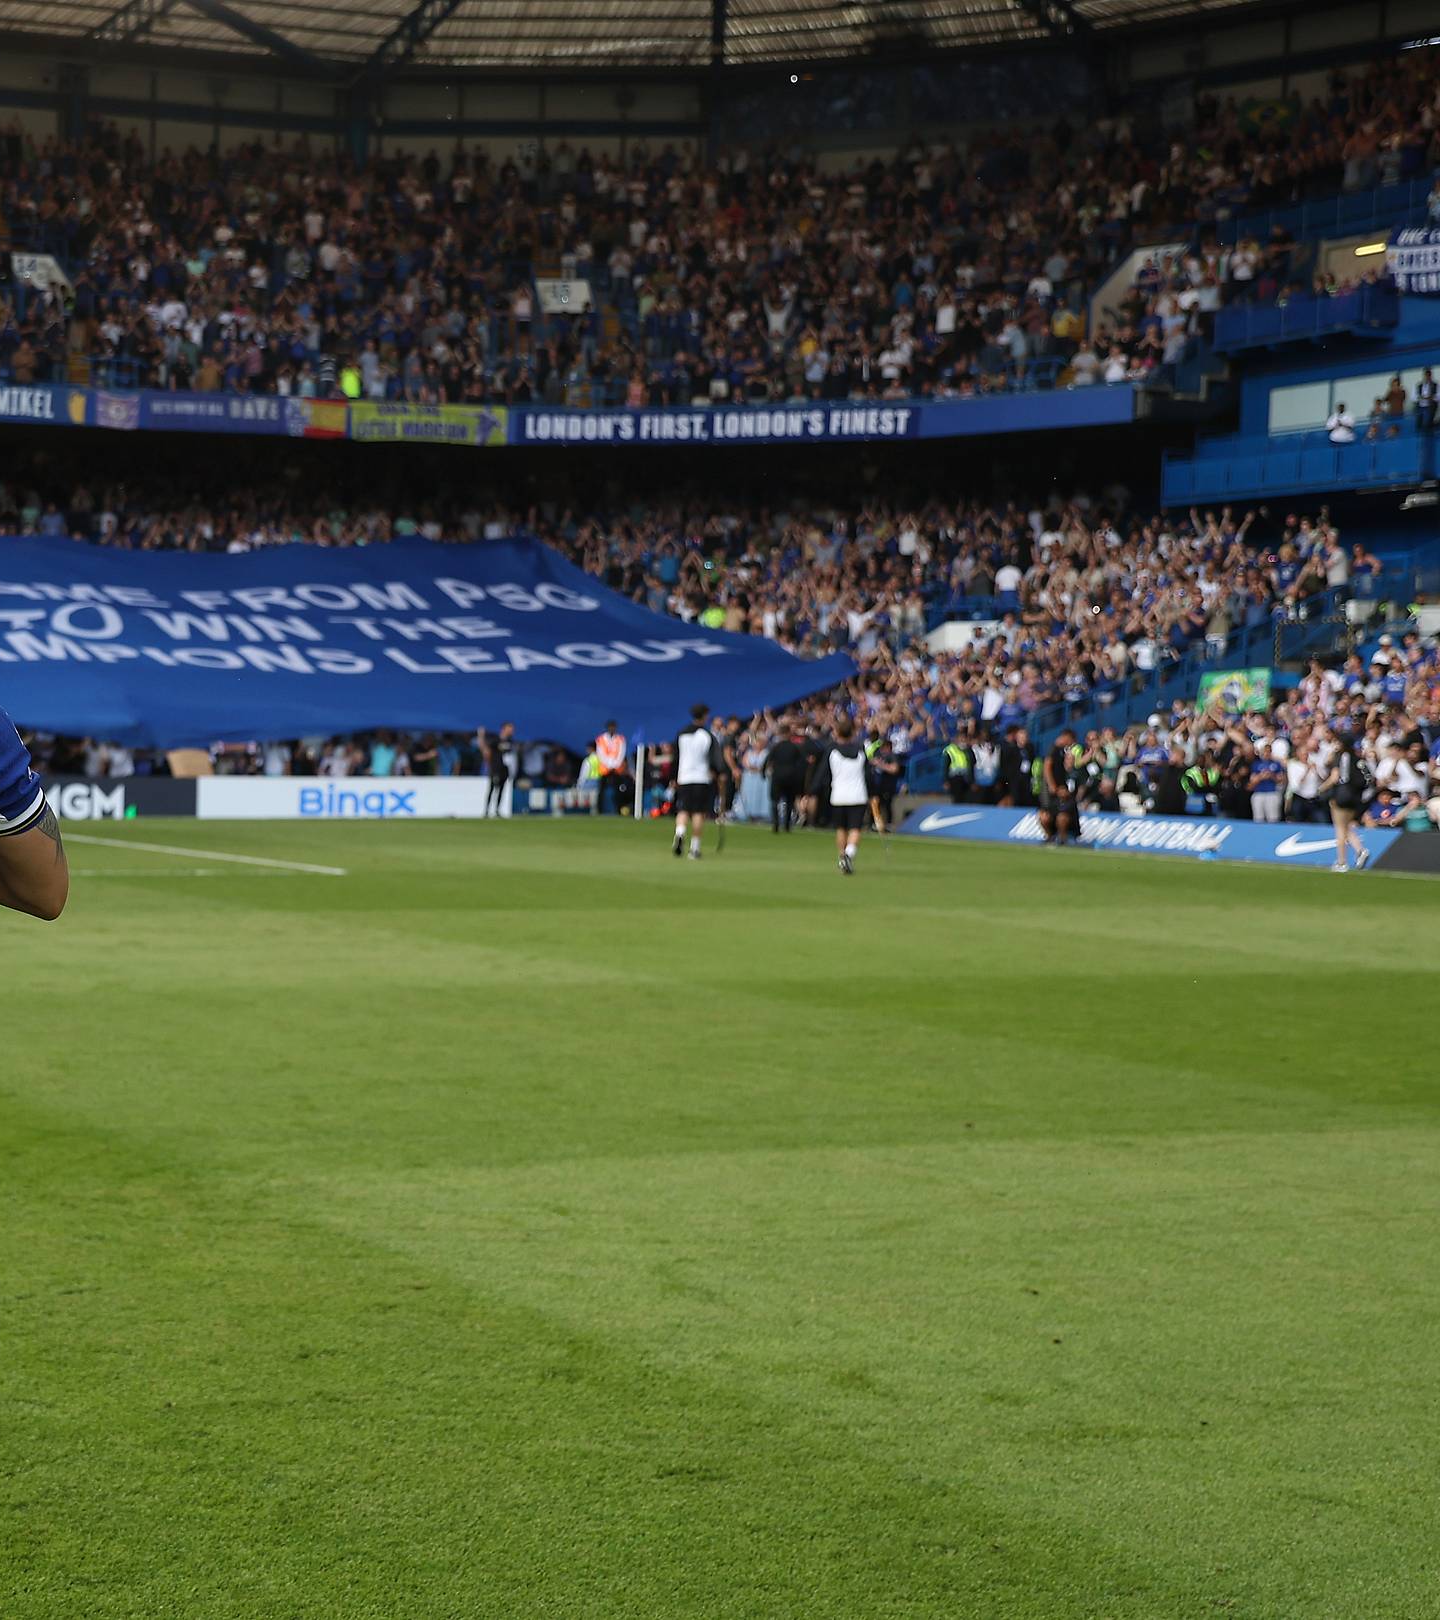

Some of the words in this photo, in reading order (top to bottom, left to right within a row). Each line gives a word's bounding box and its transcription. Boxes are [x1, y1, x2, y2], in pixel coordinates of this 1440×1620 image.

[525, 414, 635, 441] LONDON'S
[639, 413, 709, 441] FIRST,
[713, 409, 825, 438] LONDON'S
[829, 408, 910, 436] FINEST
[180, 582, 431, 612] FROM
[434, 577, 600, 612] PSG
[140, 609, 324, 641] WIN
[328, 616, 513, 641] THE
